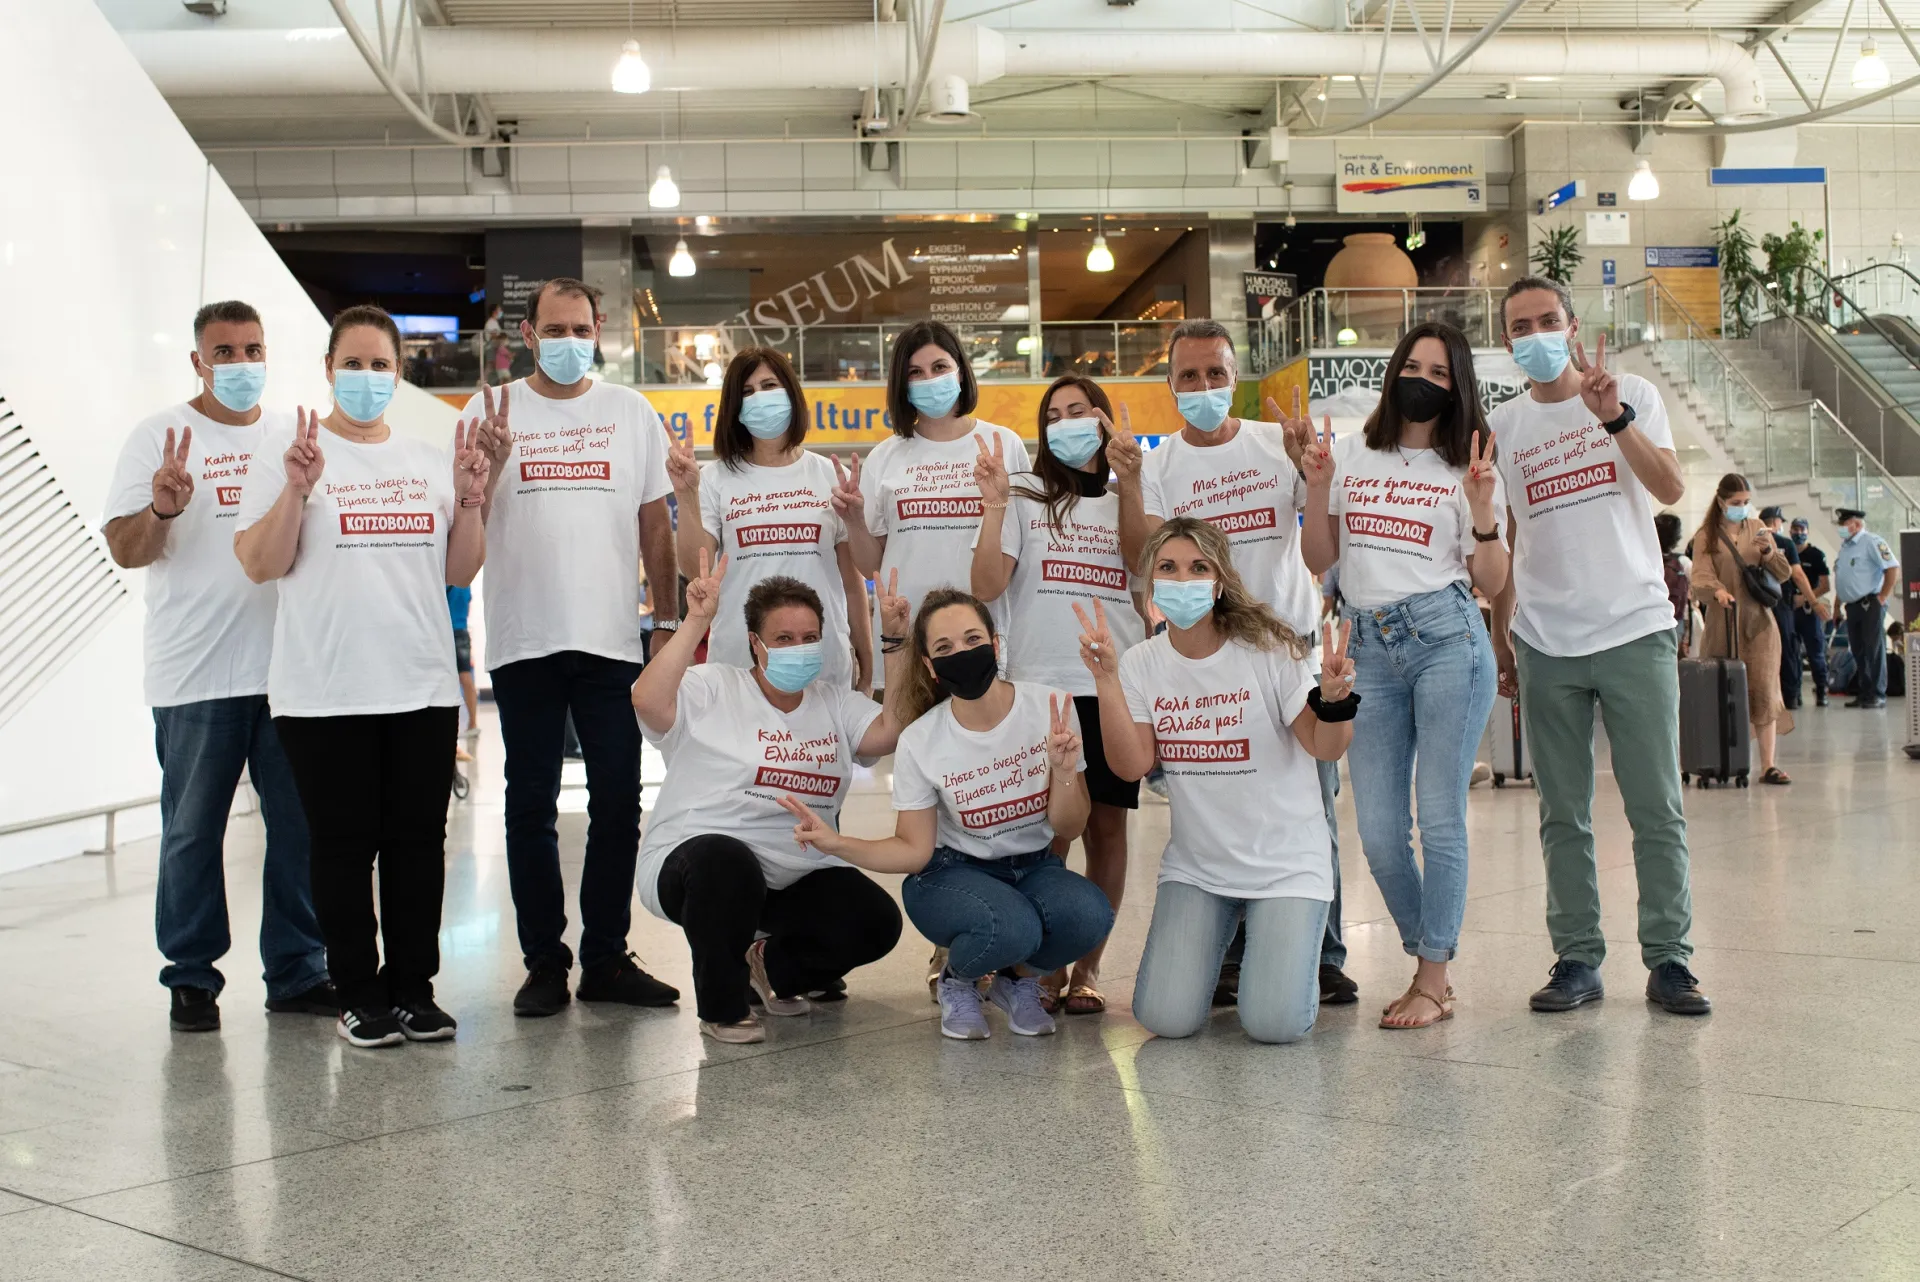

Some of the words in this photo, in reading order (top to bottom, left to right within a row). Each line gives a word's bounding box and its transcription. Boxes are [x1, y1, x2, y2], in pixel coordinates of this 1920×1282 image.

[1344, 162, 1365, 176] Art
[1370, 162, 1379, 176] &
[1385, 162, 1473, 176] Environment
[929, 265, 986, 274] ΕΥΡΗΜΑΤΩΝ
[930, 275, 975, 284] ΠΕΡΙΟΧΗΣ
[930, 285, 997, 295] ΑΕΡΟΔΡΟΜΙΟΥ
[930, 303, 981, 313] EXHIBITION
[984, 302, 997, 311] OF
[931, 312, 1002, 321] ARCHAEOLOGIC
[1309, 360, 1325, 378] Η
[1331, 358, 1389, 378] ΜΟΥΣ
[1309, 377, 1384, 397] ΑΠΟΓΕΙ
[807, 401, 898, 430] lture
[512, 431, 541, 443] Ζήστε
[544, 431, 556, 440] το
[559, 424, 593, 438] όνειρό
[596, 423, 616, 435] σας!
[519, 444, 559, 458] Είμαστε
[562, 439, 585, 455] μαζί
[589, 437, 609, 449] σας!
[1513, 445, 1541, 464] Ζήστε
[1543, 440, 1556, 450] το
[1559, 422, 1594, 443] όνειρό
[239, 453, 253, 461] επ
[1521, 456, 1561, 479] Είμαστε
[1563, 441, 1587, 465] μαζί
[1591, 434, 1612, 449] σας!
[234, 464, 248, 476] ήδ
[525, 463, 605, 478] ΚΩΤΣΟΒΟΛΟΣ
[915, 472, 928, 482] θα
[916, 461, 949, 475] καρδιά
[950, 461, 970, 472] μας
[325, 483, 357, 495] Ζήστε
[359, 484, 371, 492] το
[375, 476, 408, 489] όνειρό
[894, 487, 910, 496] στο
[913, 483, 938, 493] Τόκιο
[940, 480, 961, 493] μαζί
[1192, 478, 1218, 494] Μας
[1343, 476, 1380, 488] Είστε
[1384, 476, 1456, 496] έμπνευση!
[1530, 465, 1612, 501] ΚΩΤΣΟΒΟΛΟΣ
[336, 496, 378, 509] Είμαστε
[381, 490, 405, 507] μαζί
[730, 493, 762, 506] Καλή
[1173, 498, 1204, 516] πάντα
[1207, 474, 1278, 506] υπερήφανους!
[1347, 491, 1380, 506] Πάμε
[1385, 491, 1439, 508] δυνατά!
[725, 508, 753, 522] είστε
[756, 503, 779, 514] ήδη
[783, 499, 830, 510] νικητές!
[901, 500, 981, 516] ΚΩΤΣΟΒΟΛΟΣ
[345, 515, 431, 531] ΚΩΤΣΟΒΟΛΟΣ
[1348, 515, 1427, 542] ΚΩΤΣΟΒΟΛΟΣ
[741, 526, 818, 544] ΚΩΤΣΟΒΟΛΟΣ
[1058, 532, 1075, 542] της
[1077, 534, 1114, 546] καρδιάς
[1047, 542, 1074, 553] Καλή
[1078, 545, 1120, 556] επιτυχία!
[1046, 563, 1123, 587] ΚΩΤΣΟΒΟΛΟΣ
[1154, 696, 1190, 712] Καλή
[1195, 687, 1250, 709] επιτυχία
[1157, 714, 1210, 734] Ελλάδα
[1216, 707, 1243, 735] μας!
[758, 729, 793, 743] Καλή
[765, 745, 813, 763] Ελλάδα
[815, 748, 838, 769] μας!
[1159, 743, 1245, 759] ΚΩΤΣΟΒΟΛΟΣ
[942, 770, 975, 788] Ζήστε
[977, 765, 990, 776] το
[993, 746, 1028, 770] όνειρό
[1030, 736, 1048, 755] σας!
[760, 770, 837, 794] ΚΩΤΣΟΒΟΛΟΣ
[953, 783, 997, 805] Είμαστε
[1000, 768, 1025, 793] μαζί
[1027, 758, 1047, 777] σας!
[964, 793, 1049, 827] ΚΩΤΣΟΒΟΛΟΣ
